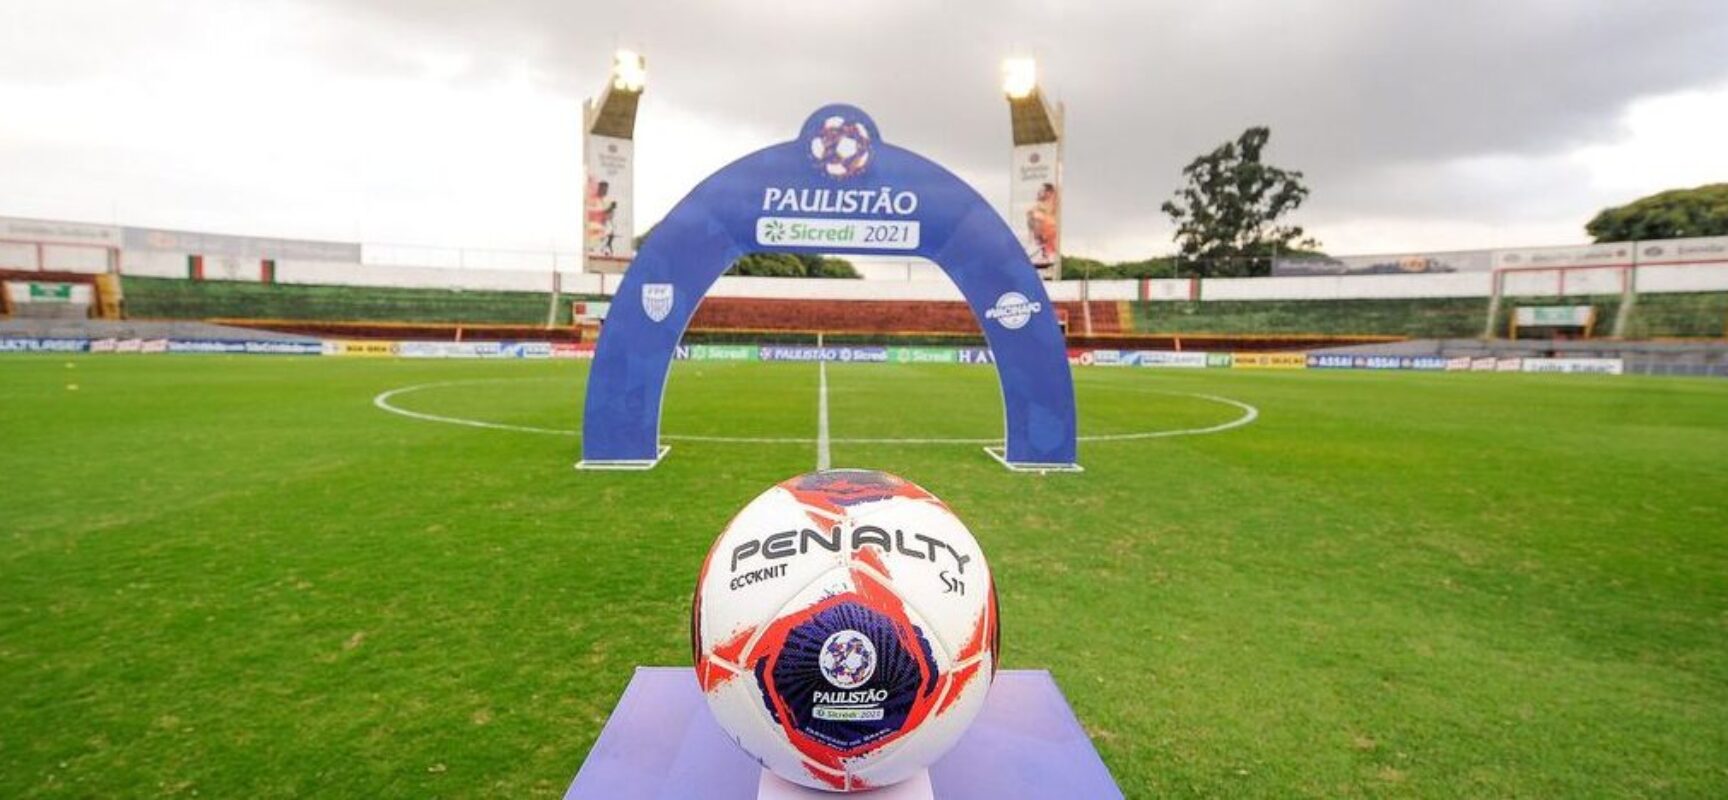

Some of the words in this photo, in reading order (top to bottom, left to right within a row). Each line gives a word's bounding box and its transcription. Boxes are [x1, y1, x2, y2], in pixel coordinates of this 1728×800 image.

[762, 186, 918, 215] PAULISTÃO
[789, 224, 856, 242] Sicredi
[863, 225, 909, 243] 2021
[775, 347, 837, 360] PAULISTÃO
[731, 525, 970, 574] PENALTY
[730, 563, 788, 590] ECOKNIT
[813, 688, 888, 704] PAULISTÃO
[860, 710, 881, 719] 2021
